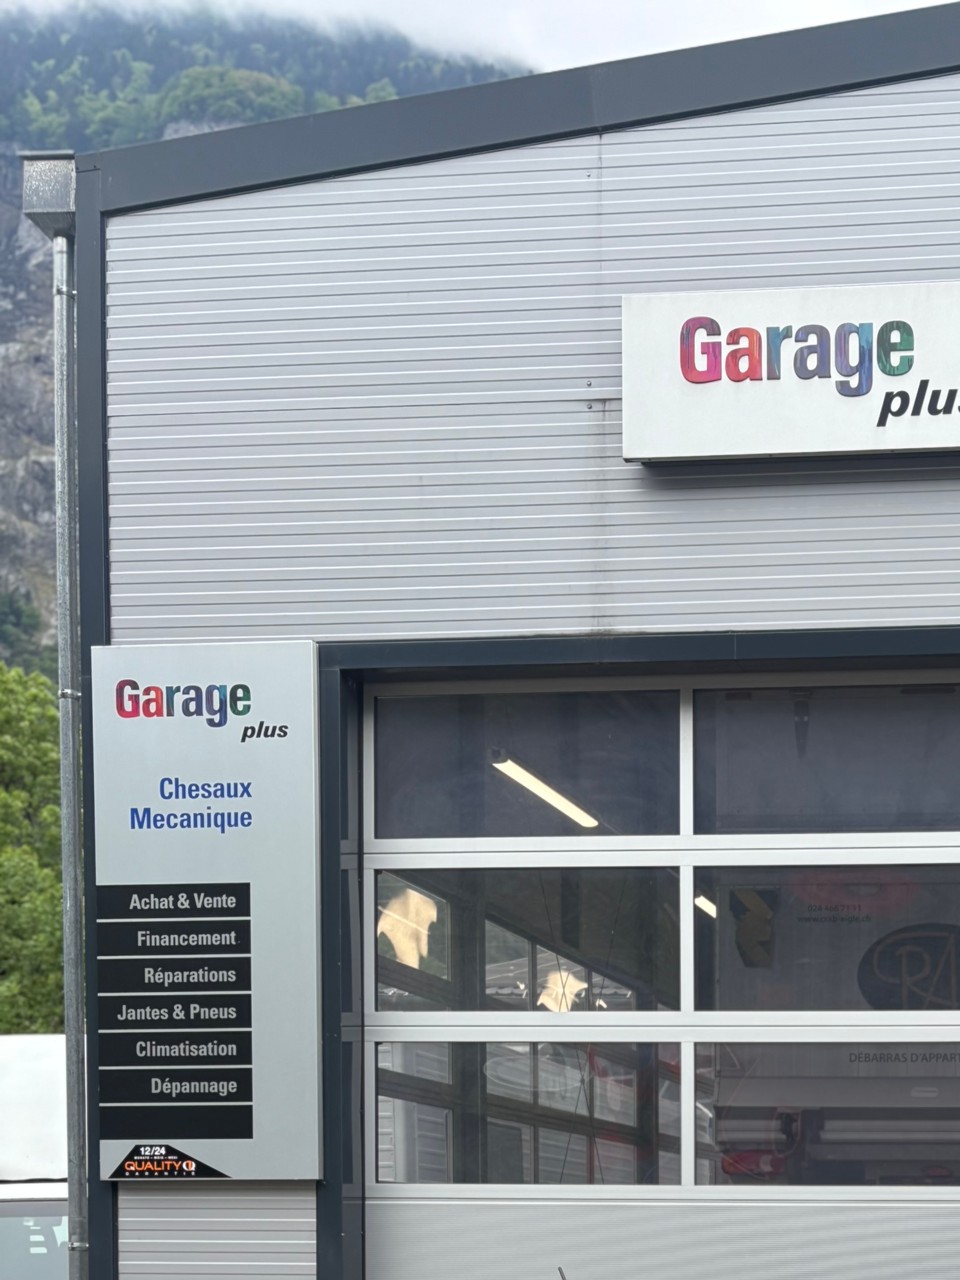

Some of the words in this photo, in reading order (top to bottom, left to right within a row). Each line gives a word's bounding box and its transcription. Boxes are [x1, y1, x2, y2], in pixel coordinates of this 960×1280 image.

[680, 315, 915, 397] Garage
[115, 678, 252, 728] Garage
[240, 721, 289, 743] plus
[159, 777, 253, 800] Chesaux
[130, 806, 253, 834] Mecanique
[129, 893, 174, 910] Achat
[177, 893, 190, 909] &
[193, 892, 237, 908] Vente
[137, 929, 237, 947] Financement
[144, 967, 237, 987] Réparations
[117, 1004, 169, 1021] Jantes
[172, 1003, 185, 1020] &
[190, 1003, 237, 1020] Pneus
[136, 1040, 237, 1057] Climatisation
[849, 1051, 907, 1063] DÉBARRAS
[151, 1077, 238, 1098] Dépannage
[140, 1146, 166, 1155] 12/24
[124, 1160, 182, 1171] QUALITY
